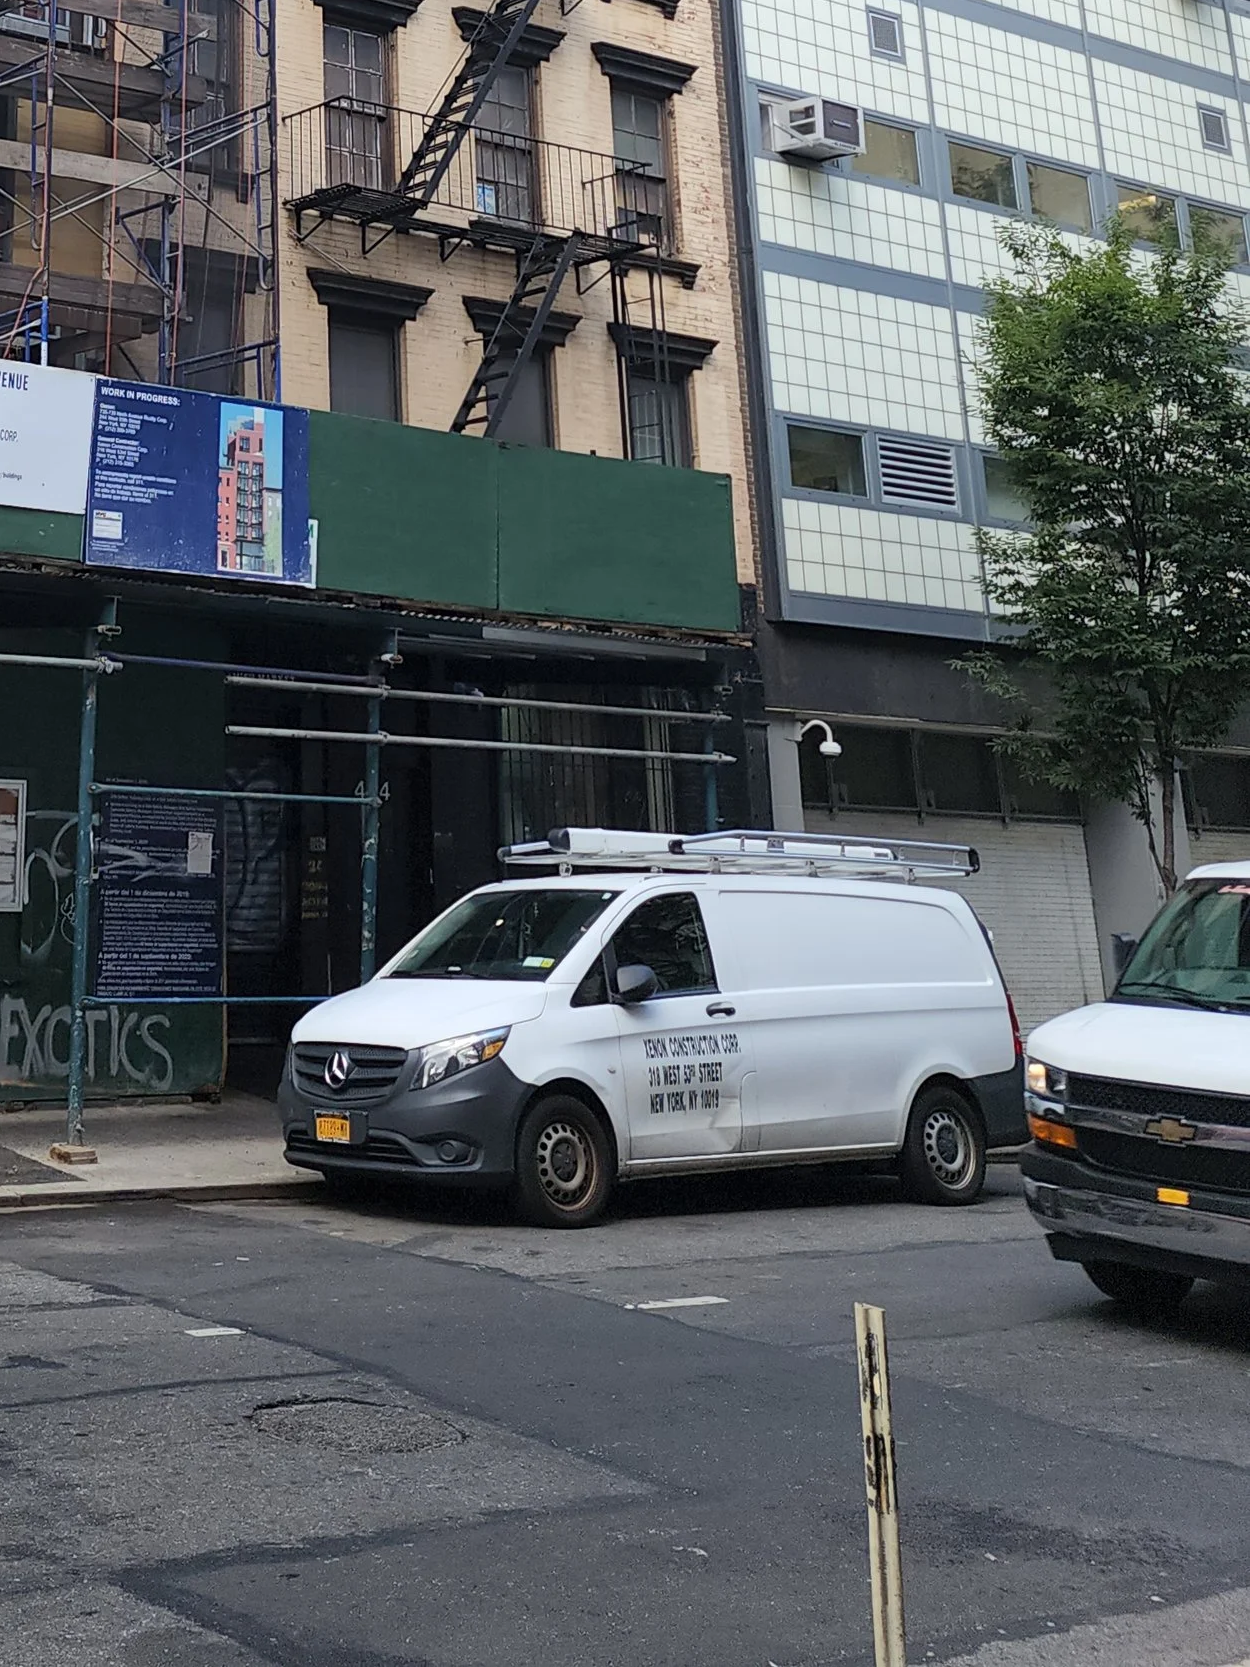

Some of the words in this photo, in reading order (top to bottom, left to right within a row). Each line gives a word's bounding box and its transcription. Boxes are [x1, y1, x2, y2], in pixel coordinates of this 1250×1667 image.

[101, 386, 126, 398] WORK
[126, 390, 135, 400] IN
[136, 392, 181, 406] PROGRESS:
[0, 429, 19, 443] CORP.
[354, 780, 390, 801] 44
[643, 1037, 669, 1059] XENON
[669, 1034, 721, 1058] CONSTRUCTION
[721, 1033, 742, 1054] CORP.
[649, 1066, 661, 1087] 318
[662, 1064, 680, 1085] WEST
[699, 1062, 723, 1083] STREET
[650, 1092, 664, 1114] NEW
[667, 1091, 687, 1114] YORK,
[689, 1090, 698, 1111] NY
[701, 1089, 720, 1109] 10019
